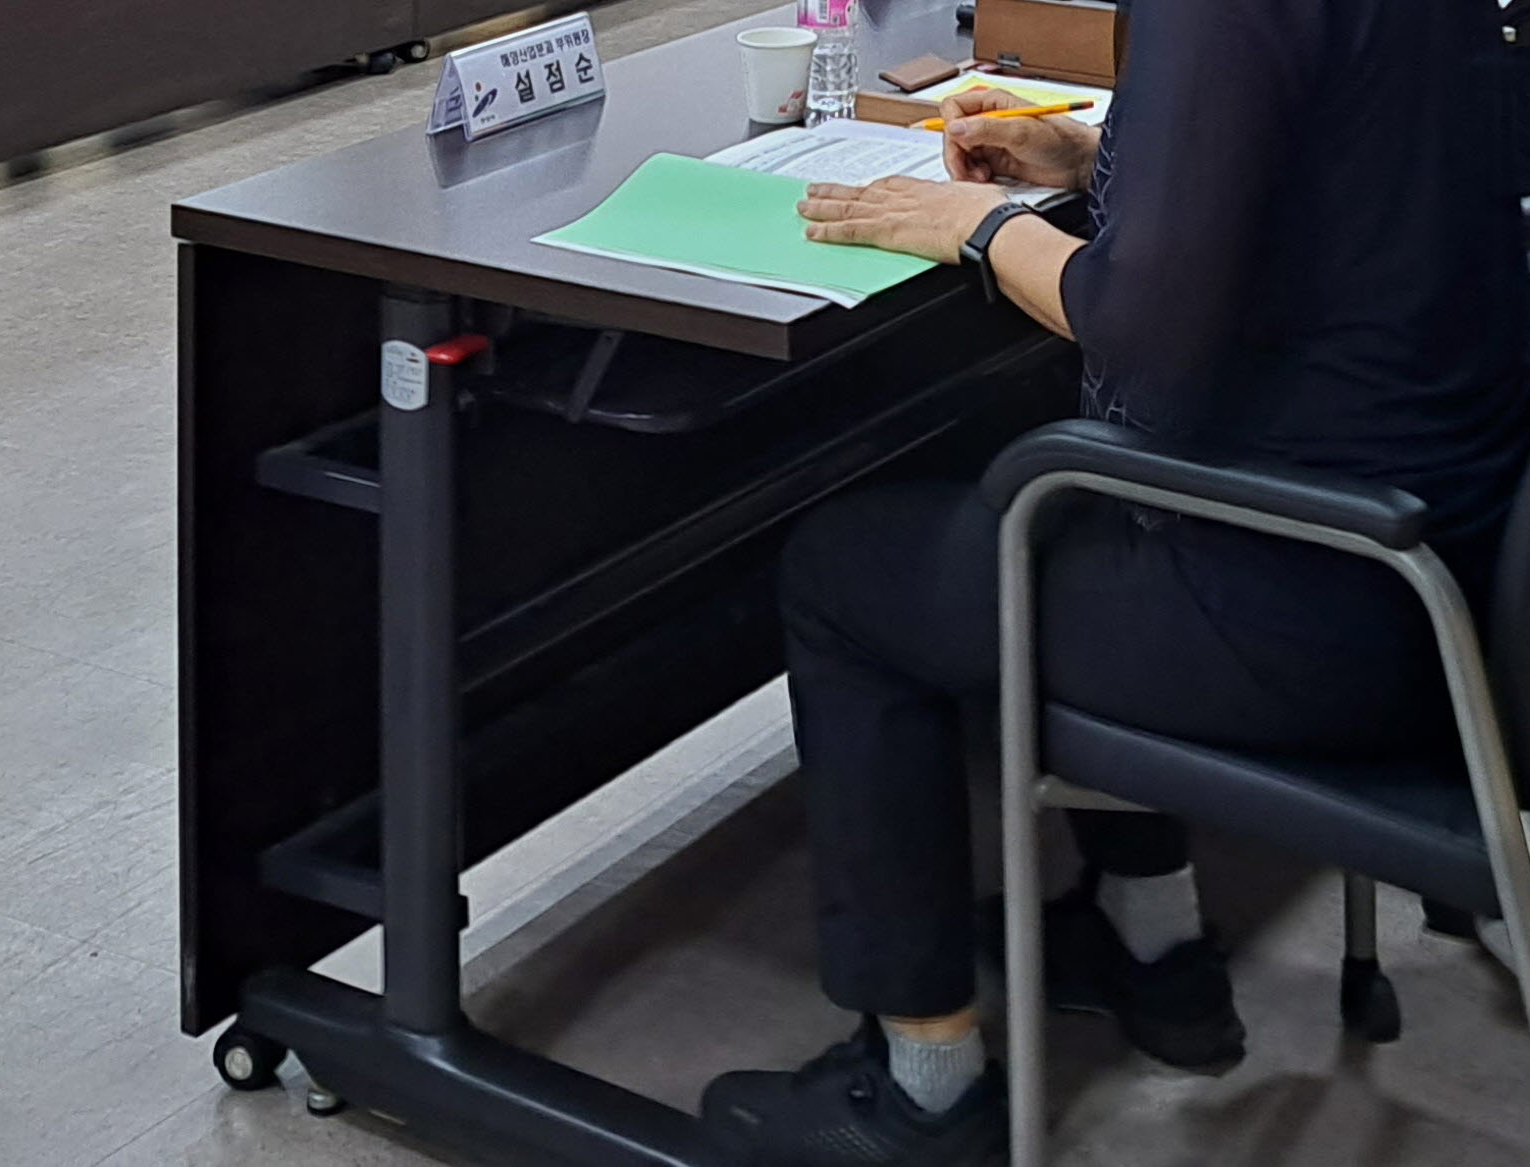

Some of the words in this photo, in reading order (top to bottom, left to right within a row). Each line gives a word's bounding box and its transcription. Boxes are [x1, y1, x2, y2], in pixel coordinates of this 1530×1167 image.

[499, 41, 555, 68] 해양산업분과
[555, 28, 591, 51] 부위원장
[514, 51, 595, 104] 설점순
